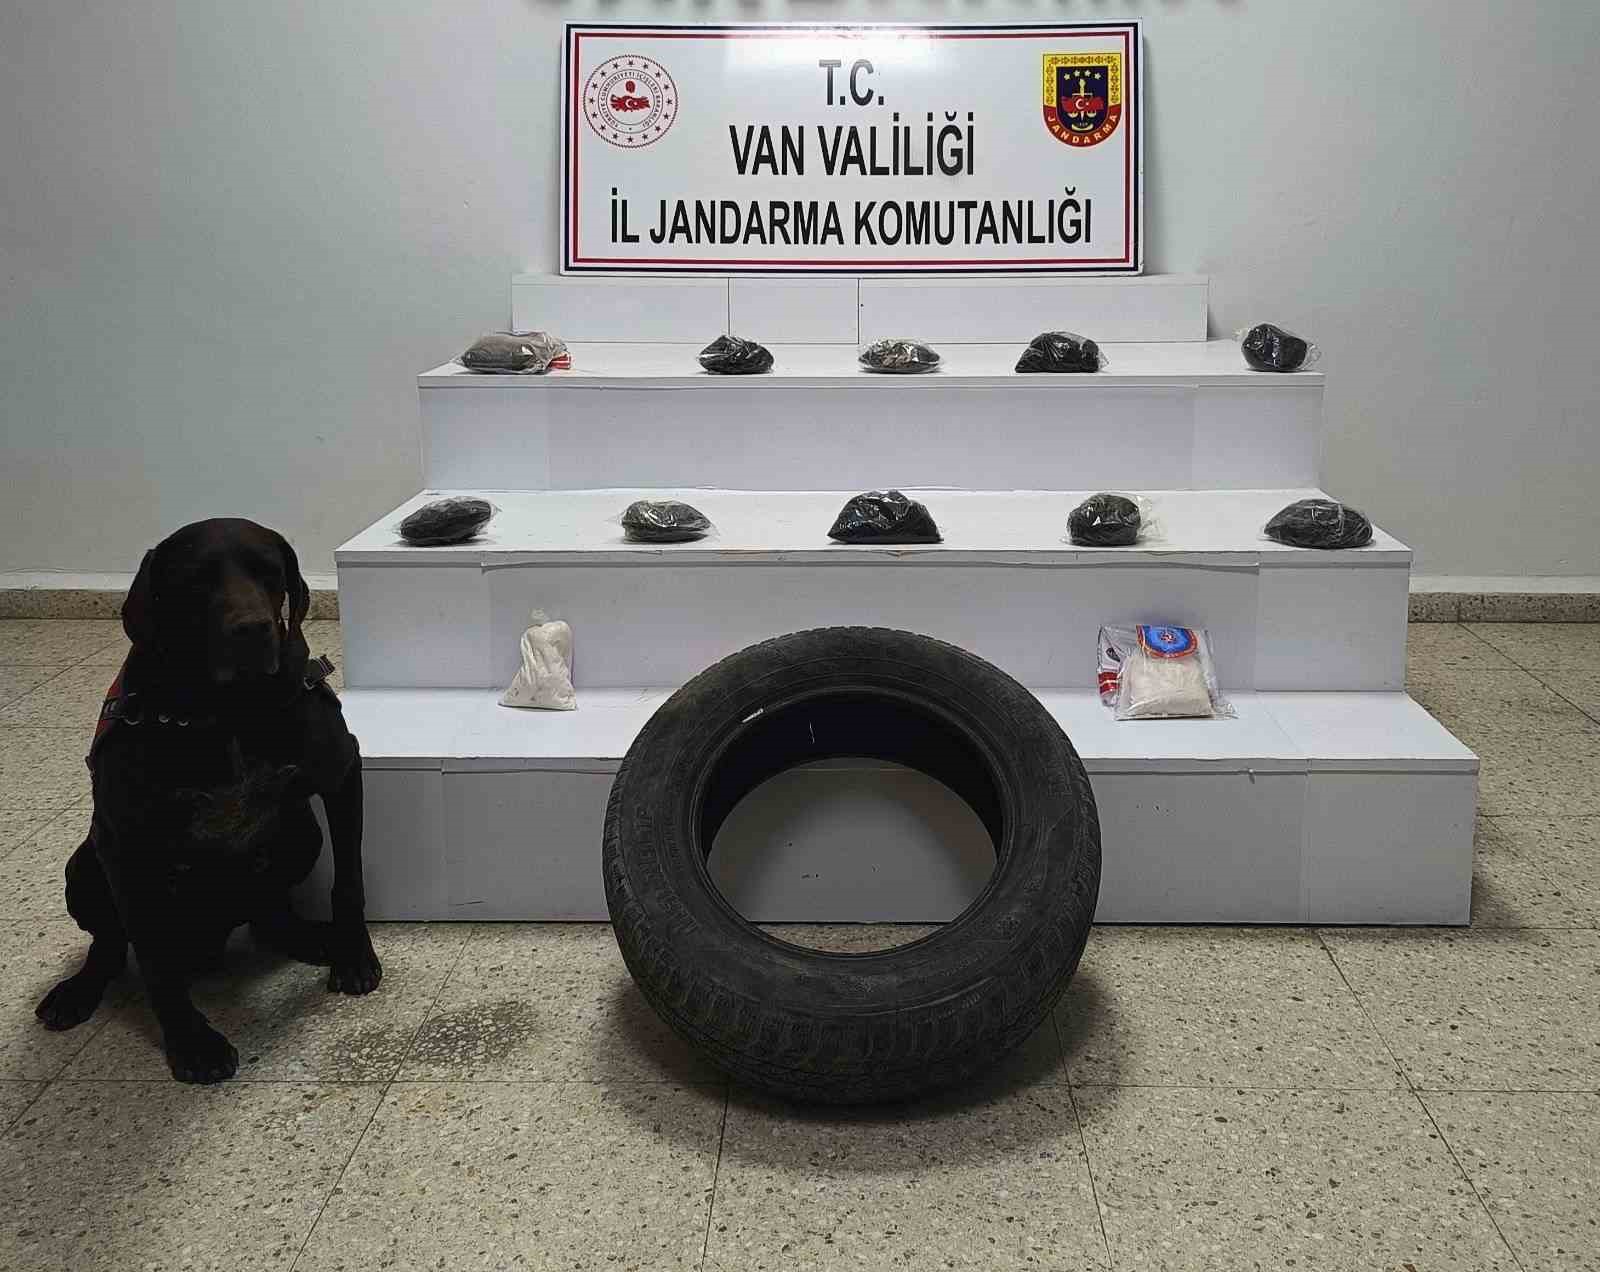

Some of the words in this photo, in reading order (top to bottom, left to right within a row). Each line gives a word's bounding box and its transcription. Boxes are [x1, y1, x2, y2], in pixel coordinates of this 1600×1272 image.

[819, 60, 885, 106] T.C.
[729, 125, 804, 175] VAN
[817, 112, 973, 176] VALİLİĞİ
[1047, 114, 1118, 144] JANDARMA
[611, 187, 640, 243] İL
[650, 200, 844, 244] JANDARMA
[855, 187, 1091, 245] KOMUTANLIĞI
